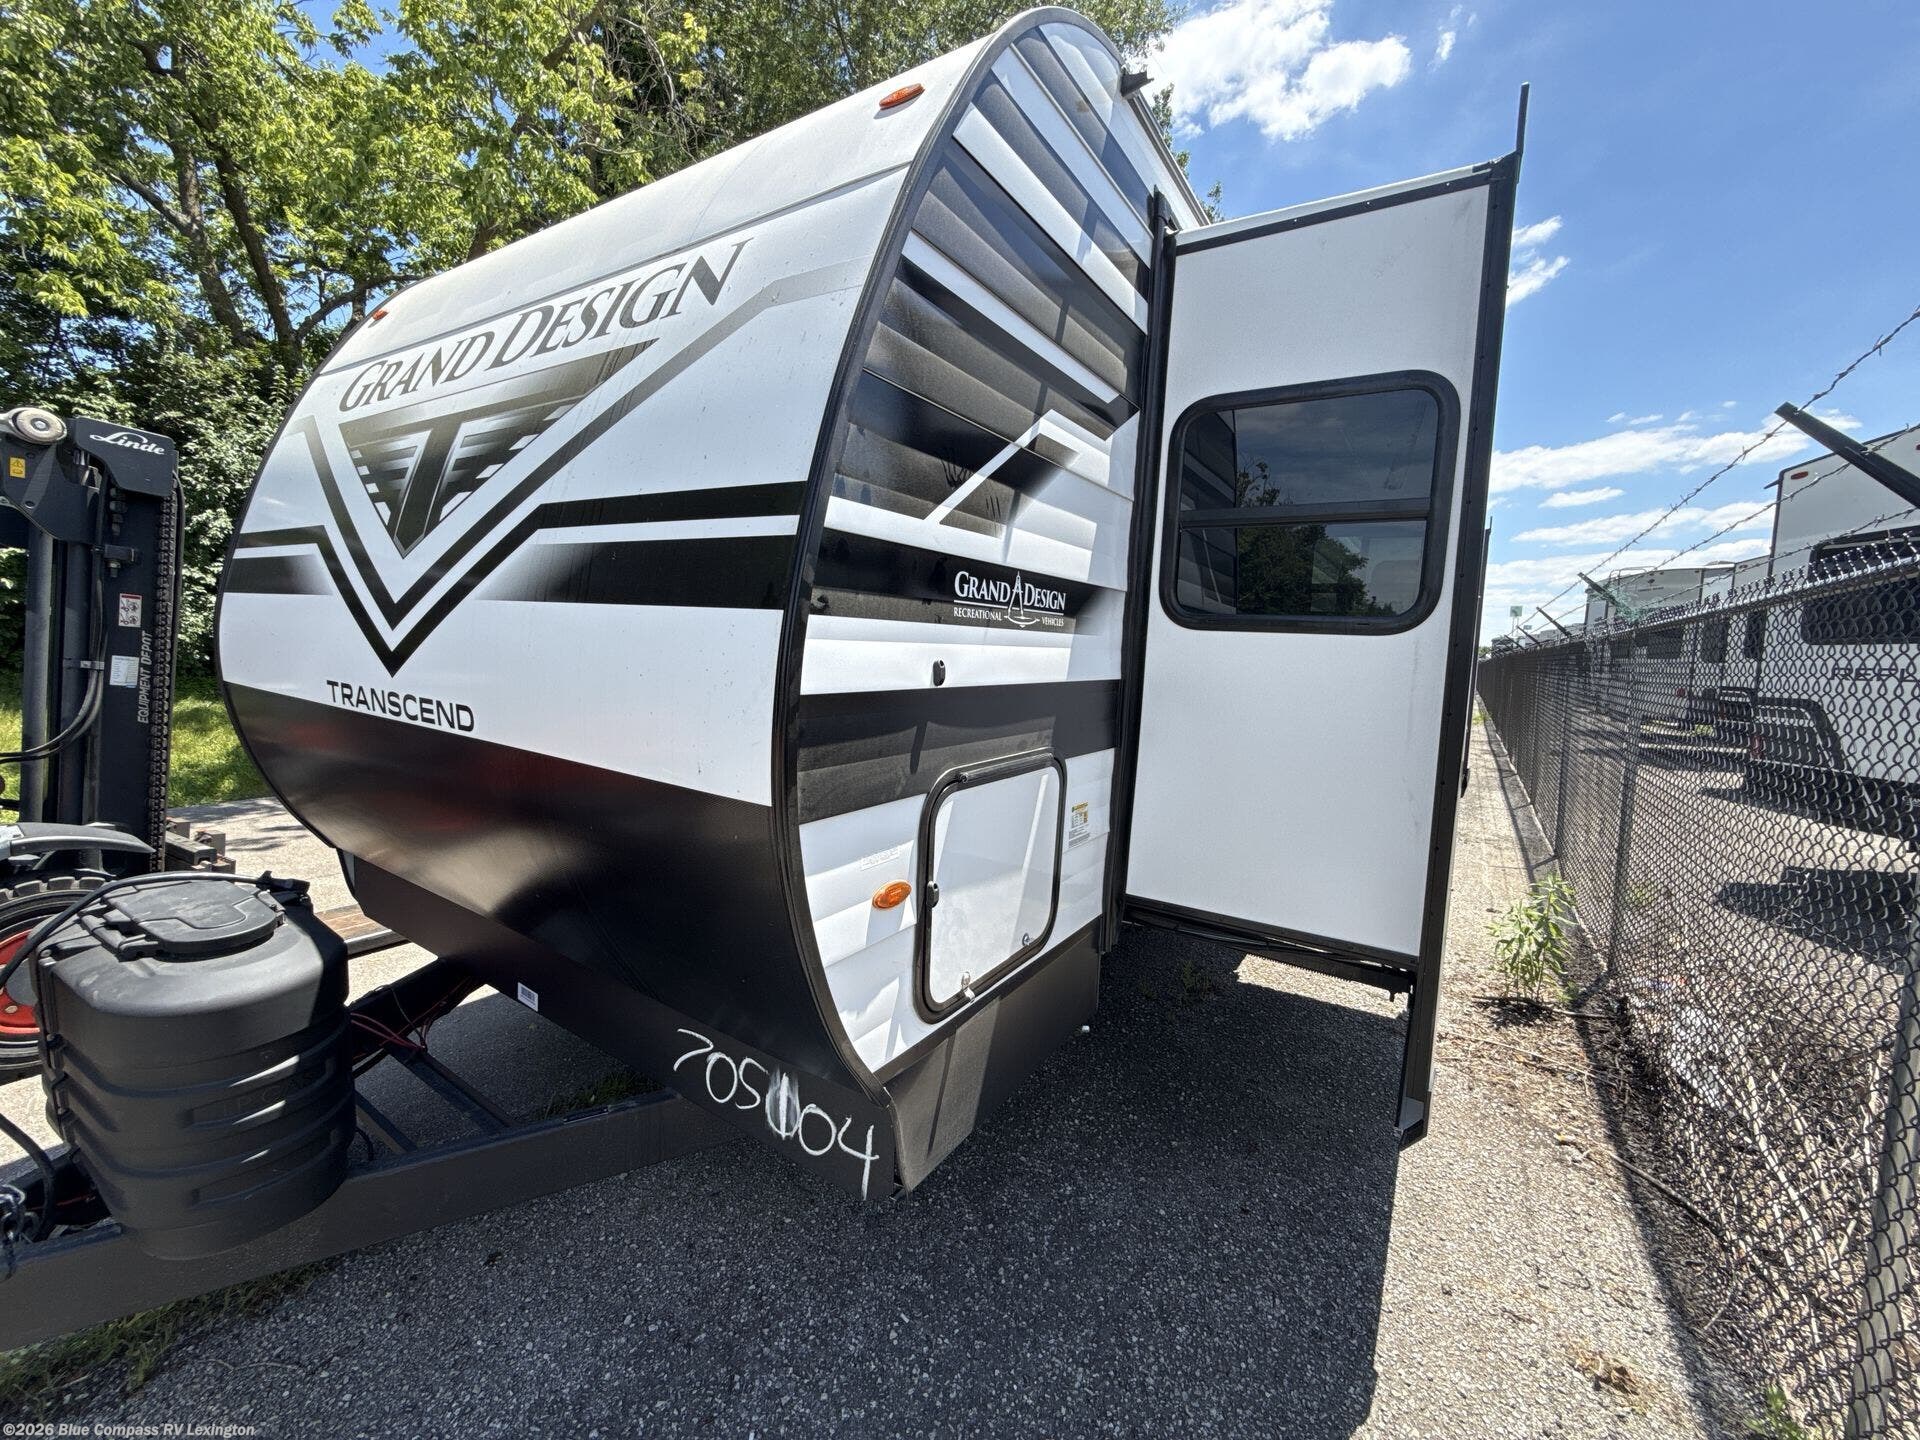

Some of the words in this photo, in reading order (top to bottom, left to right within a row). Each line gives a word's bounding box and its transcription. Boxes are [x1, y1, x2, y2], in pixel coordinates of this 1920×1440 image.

[339, 331, 495, 412] GRAND
[485, 237, 754, 372] DESIGN
[90, 432, 165, 455] Linde
[954, 570, 1011, 603] GRAND
[1023, 582, 1067, 611] DESIGN
[953, 606, 1002, 621] RECREATIONAL
[1041, 616, 1065, 627] VEHICLES
[137, 671, 152, 724] EQUIPMENT
[326, 679, 475, 732] TRANSCEND
